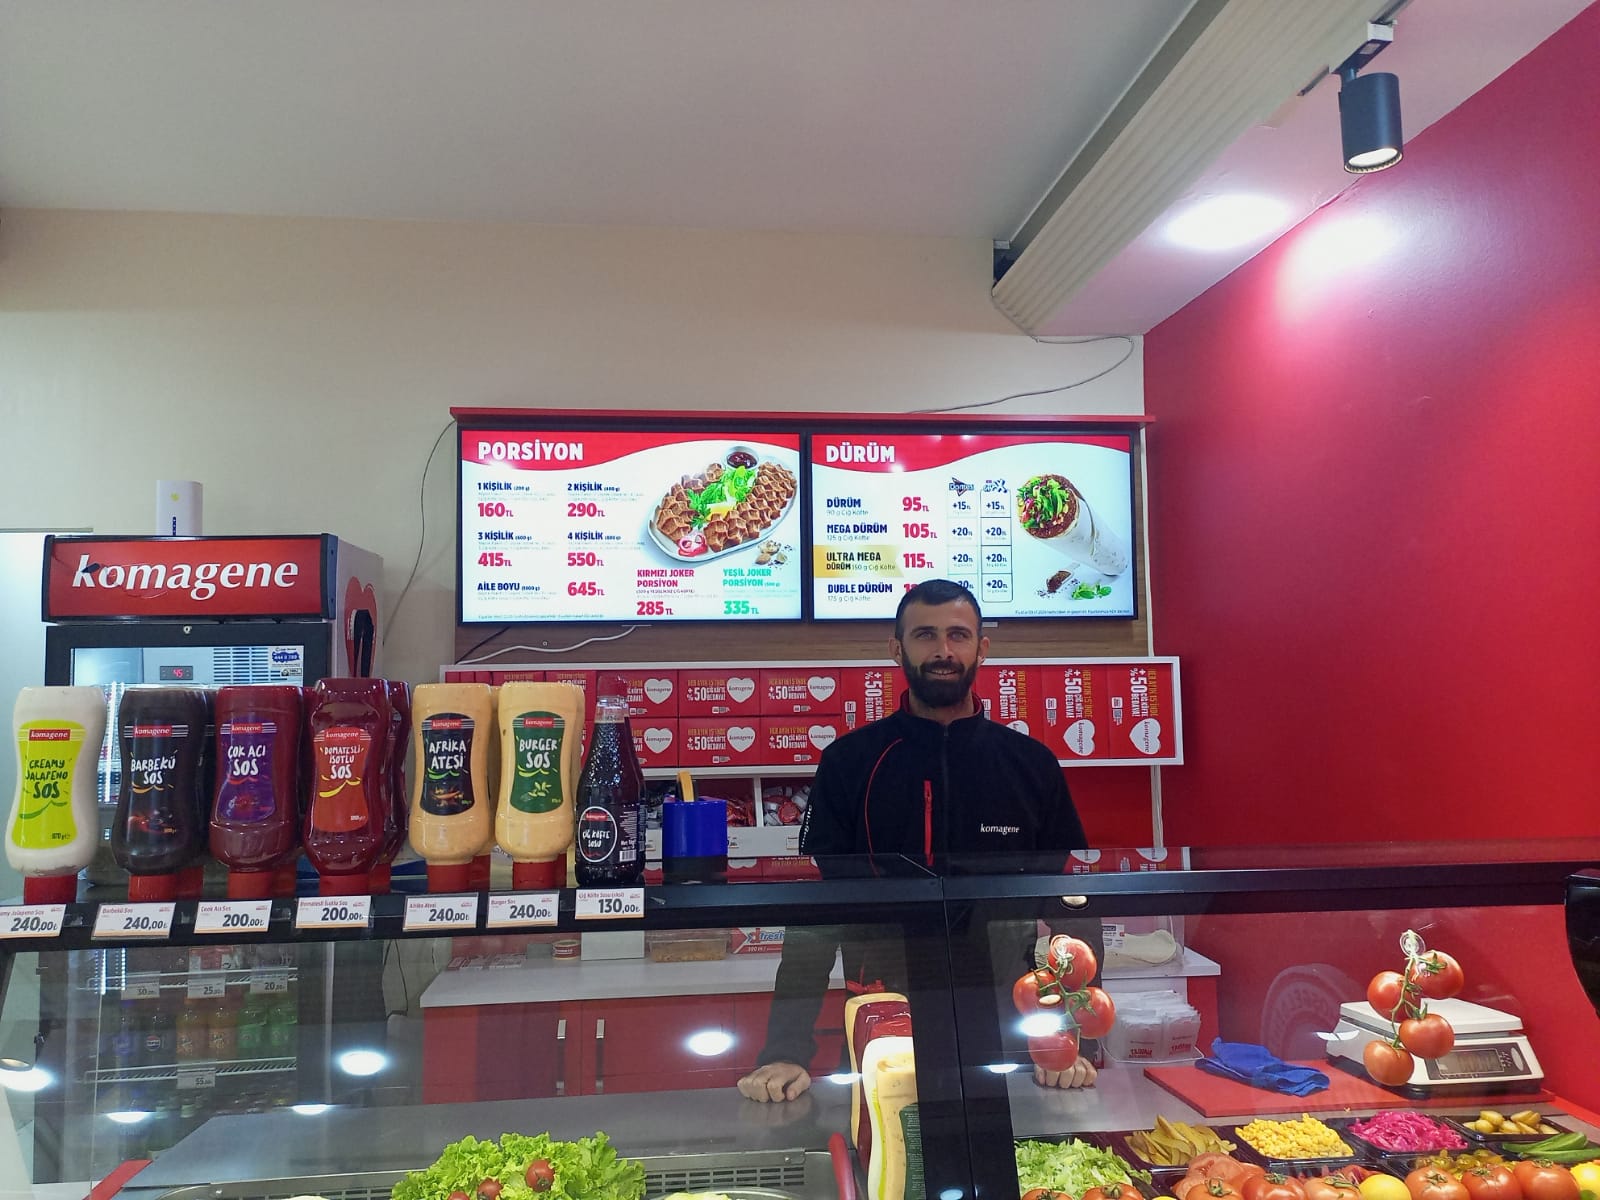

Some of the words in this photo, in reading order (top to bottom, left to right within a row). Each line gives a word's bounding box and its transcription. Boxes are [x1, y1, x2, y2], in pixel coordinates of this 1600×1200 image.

[478, 439, 584, 461] PORSİYON
[826, 442, 895, 463] DÜRÜM
[478, 483, 482, 491] 1
[483, 481, 512, 492] KİŞİLİK
[567, 483, 573, 491] 2
[574, 481, 602, 493] KİŞİLİK
[827, 496, 861, 508] DÜRÜM
[827, 524, 851, 534] MEGA
[852, 522, 888, 534] DÜRÜM
[478, 532, 483, 541] 3
[484, 530, 514, 542] KİŞİLİK
[567, 532, 573, 541] 4
[574, 530, 603, 542] KİŞİLİK
[826, 552, 855, 562] ULTRA
[857, 552, 882, 562] MEGA
[826, 562, 851, 571] DÜRÜM
[72, 554, 298, 601] komagene
[637, 569, 668, 578] KIRMIZI
[669, 569, 695, 578] JOKER
[723, 568, 745, 580] YEŞİL
[747, 569, 771, 578] JOKER
[478, 581, 497, 592] AİLE
[497, 583, 520, 592] BOYU
[637, 578, 679, 588] PORSİYON
[722, 578, 764, 588] PORSİYON
[828, 584, 856, 594] DUBLE
[858, 581, 893, 593] DÜRÜM
[31, 729, 68, 740] komagene
[134, 727, 170, 737] komagene
[326, 731, 359, 741] komagene
[429, 738, 467, 754] AFRİKA
[519, 738, 557, 752] BURGER
[227, 745, 245, 759] ÇOK
[248, 745, 266, 758] ACI
[29, 758, 65, 769] CREAMY
[130, 755, 176, 772] BARBEKÜ
[431, 752, 463, 770] ATEŞİ
[525, 751, 551, 769] SOS
[233, 758, 259, 776] SOS
[330, 764, 352, 780] SOS
[25, 770, 68, 781] JALAPENO
[143, 770, 164, 785] SOS
[33, 781, 61, 799] SOS
[980, 823, 1020, 836] komagene
